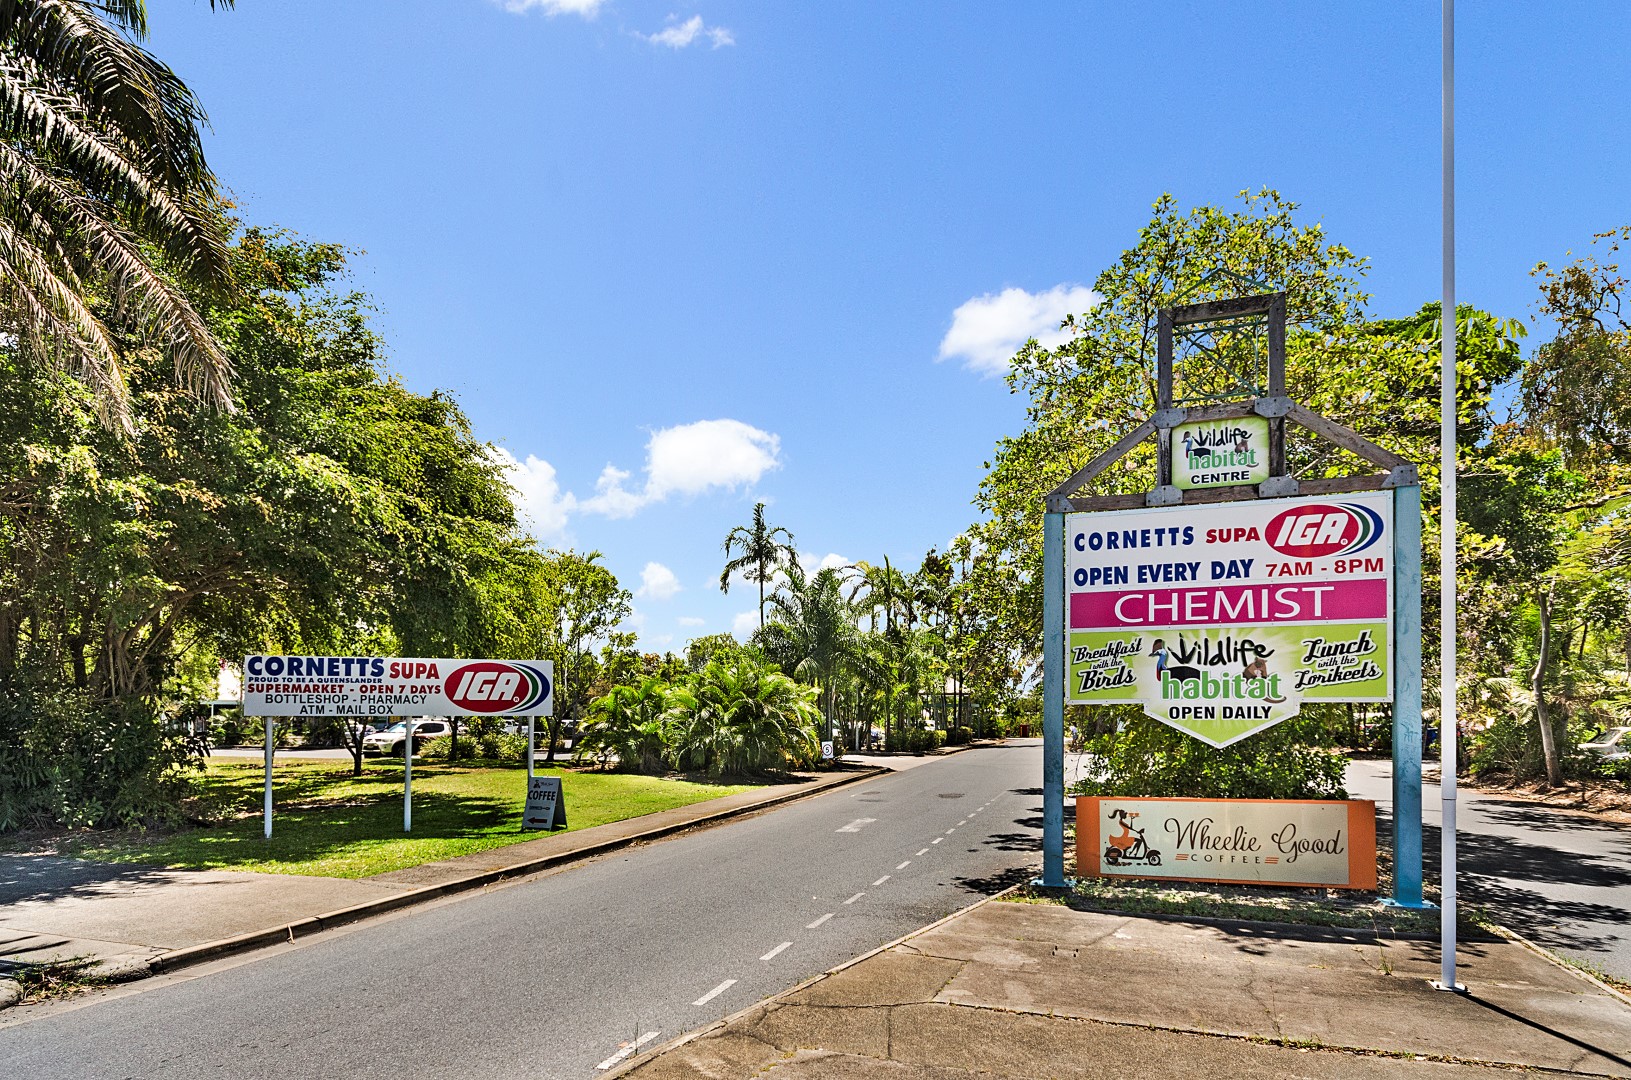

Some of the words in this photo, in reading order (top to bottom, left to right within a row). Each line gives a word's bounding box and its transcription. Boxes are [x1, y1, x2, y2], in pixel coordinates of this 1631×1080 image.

[1191, 426, 1253, 447] Wildlife
[1189, 448, 1257, 470] habitat
[1190, 470, 1250, 485] CENTRE
[1073, 526, 1195, 552] CORNETTS
[1205, 527, 1261, 544] SUPA
[1274, 512, 1349, 547] IGA
[1073, 565, 1129, 587] OPEN
[1137, 561, 1202, 584] EVERY
[1211, 558, 1255, 580] DAY
[1265, 561, 1313, 578] 7AM
[1334, 557, 1385, 574] 8PM
[1114, 586, 1335, 624] CHEMIST
[1074, 638, 1143, 663] Breakfast
[1167, 632, 1275, 667] Wildlife
[1302, 631, 1374, 663] Lunch
[1092, 660, 1110, 671] with
[1110, 658, 1123, 668] the
[1317, 657, 1339, 669] with
[1340, 654, 1357, 666] the
[247, 656, 385, 677] CORNETTS
[389, 662, 440, 680] SUPA
[452, 671, 521, 701] IGA
[247, 684, 345, 694] SUPERMARKET
[359, 684, 394, 694] OPEN
[399, 685, 406, 694] 7
[410, 685, 441, 694] DAYS
[1079, 665, 1137, 692] Birds
[1161, 671, 1282, 700] habitat
[265, 694, 349, 704] BOTTLESHOP
[360, 695, 427, 705] PHARMACY
[299, 705, 325, 715] ATM
[336, 705, 366, 715] MAIL
[368, 705, 394, 715] BOX
[1168, 706, 1216, 720] OPEN
[1222, 705, 1273, 720] DAILY
[528, 790, 557, 801] COFFEE
[1164, 817, 1262, 852] Wheelie
[1271, 823, 1344, 863] Good
[1190, 853, 1261, 864] COFFEE
